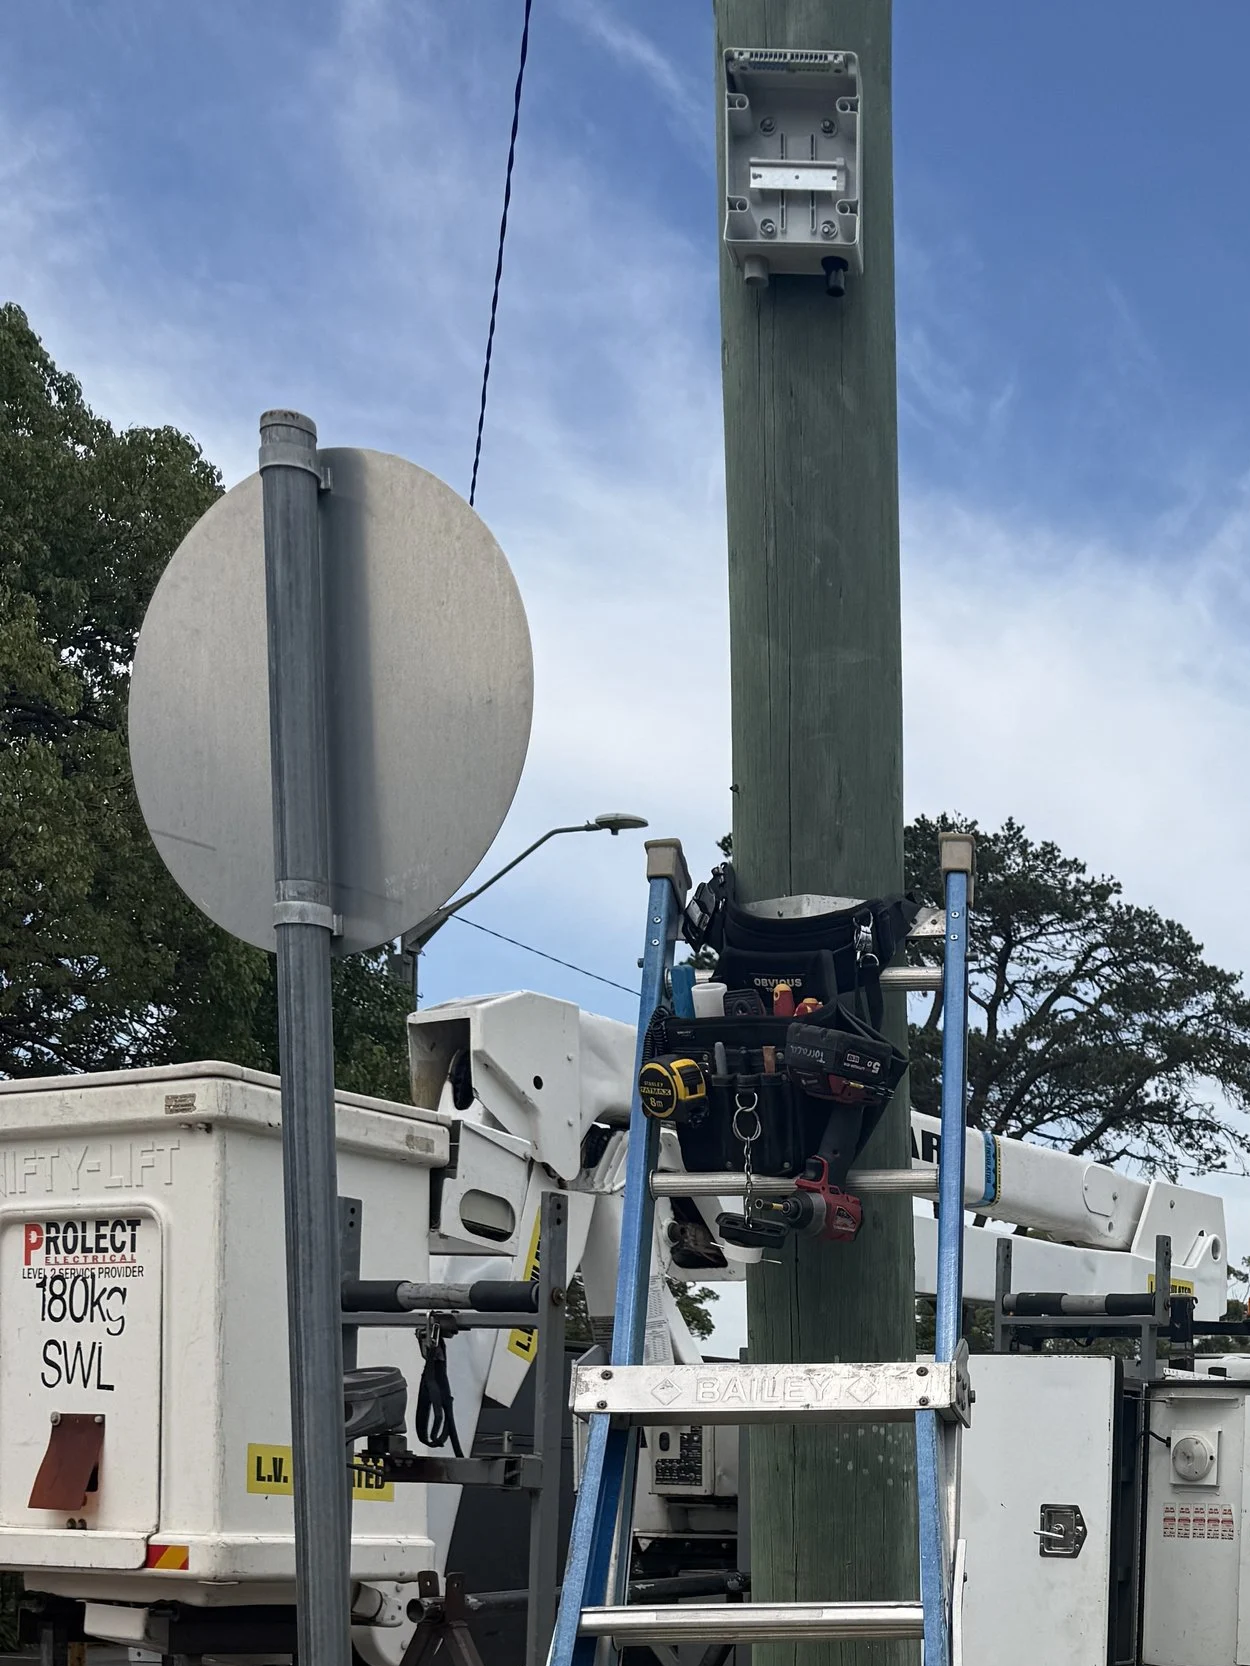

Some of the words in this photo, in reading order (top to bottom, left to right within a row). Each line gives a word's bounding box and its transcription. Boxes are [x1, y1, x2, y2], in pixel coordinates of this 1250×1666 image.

[754, 978, 802, 987] OBVIOUS
[24, 1219, 142, 1266] PROLECT
[22, 1268, 47, 1280] LEVEL
[59, 1267, 95, 1279] SERVICE
[98, 1265, 144, 1279] PROVIDER
[45, 1254, 137, 1265] ELECTRICAL
[36, 1273, 127, 1336] 180kg
[41, 1339, 115, 1391] SWL
[696, 1376, 834, 1403] BAILEY
[256, 1456, 289, 1483] L.V.
